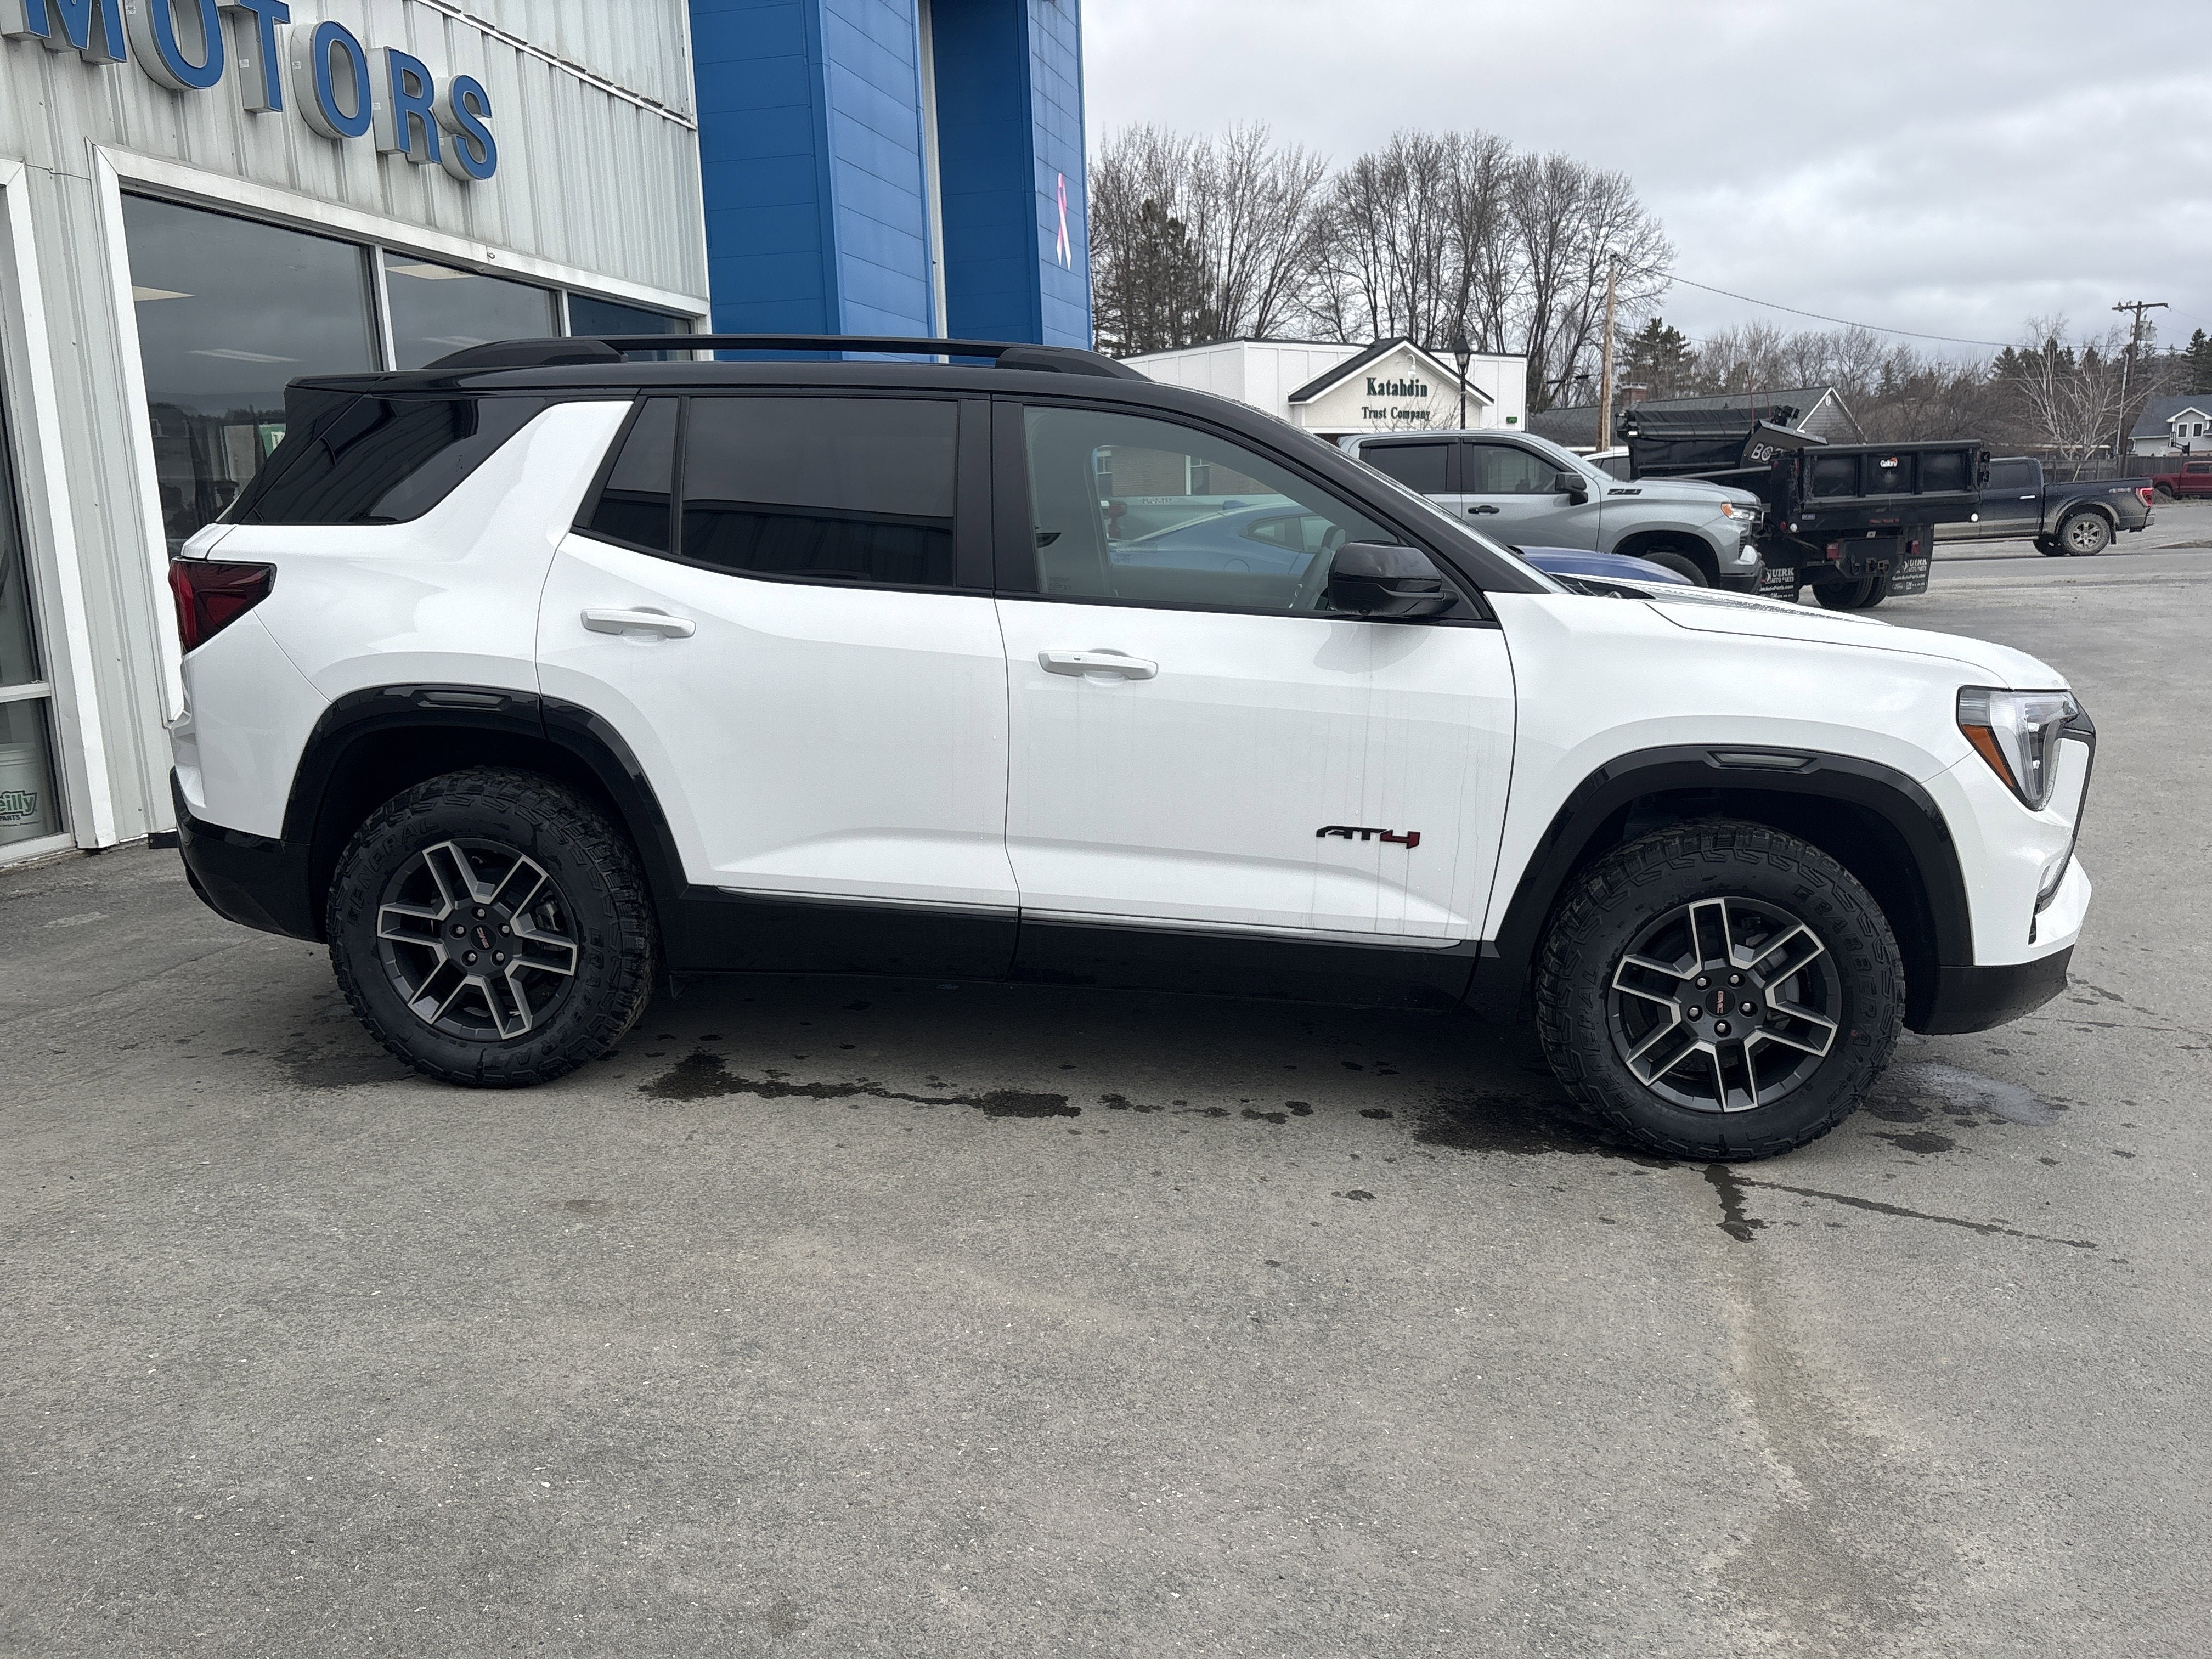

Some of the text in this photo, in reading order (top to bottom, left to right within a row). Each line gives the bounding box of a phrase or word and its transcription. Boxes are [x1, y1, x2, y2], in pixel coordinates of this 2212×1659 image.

[1366, 377, 1427, 397] Katahdin
[1362, 406, 1430, 422] Trust Company
[1316, 825, 1421, 849] AT4
[476, 927, 490, 949] GMC
[1787, 884, 1877, 1019] GRABBER
[1577, 964, 1638, 1109] GENERAL
